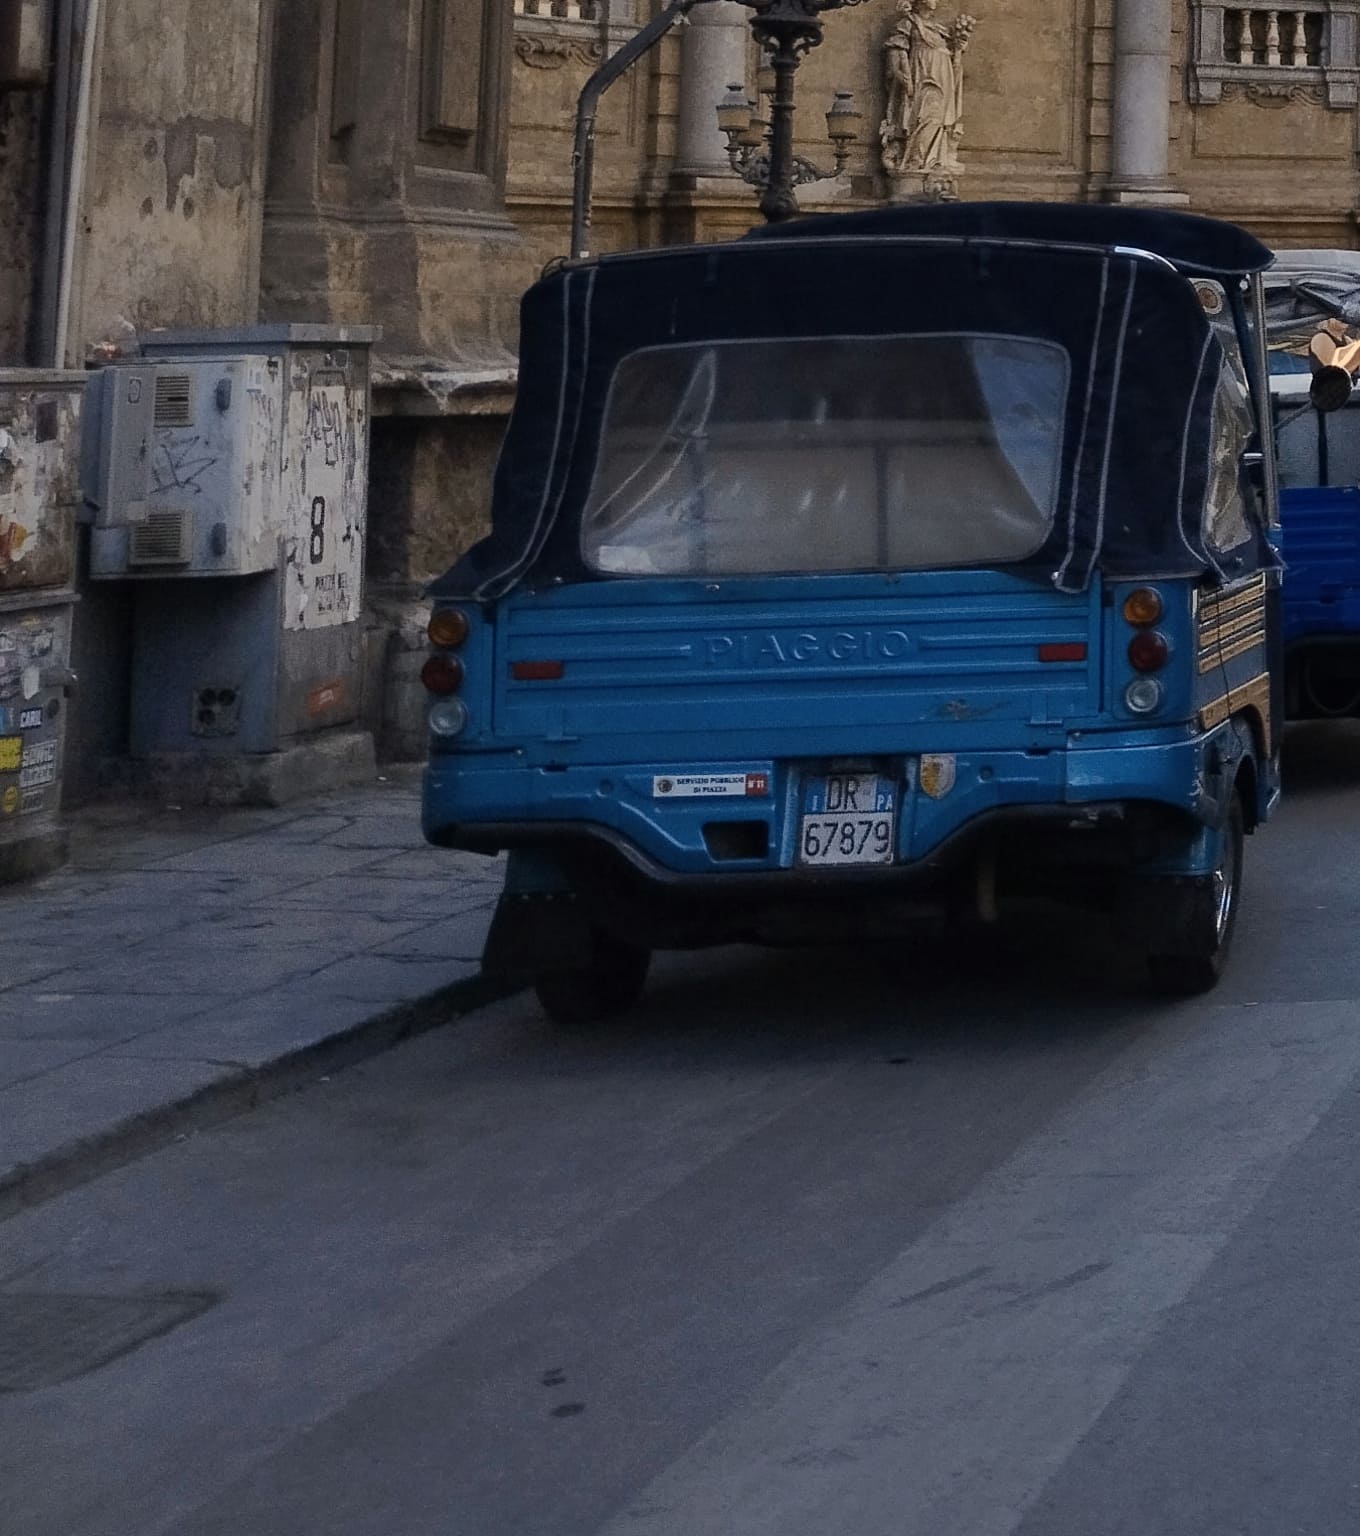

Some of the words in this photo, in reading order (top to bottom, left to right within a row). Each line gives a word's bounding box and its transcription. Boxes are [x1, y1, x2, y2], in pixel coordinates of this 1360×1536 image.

[703, 630, 911, 663] PIAGGIO
[677, 777, 709, 785] SERVIZIO
[710, 776, 744, 784] PUBBLICO
[826, 777, 860, 810] DR
[877, 794, 893, 810] PA
[804, 820, 890, 857] 67879
